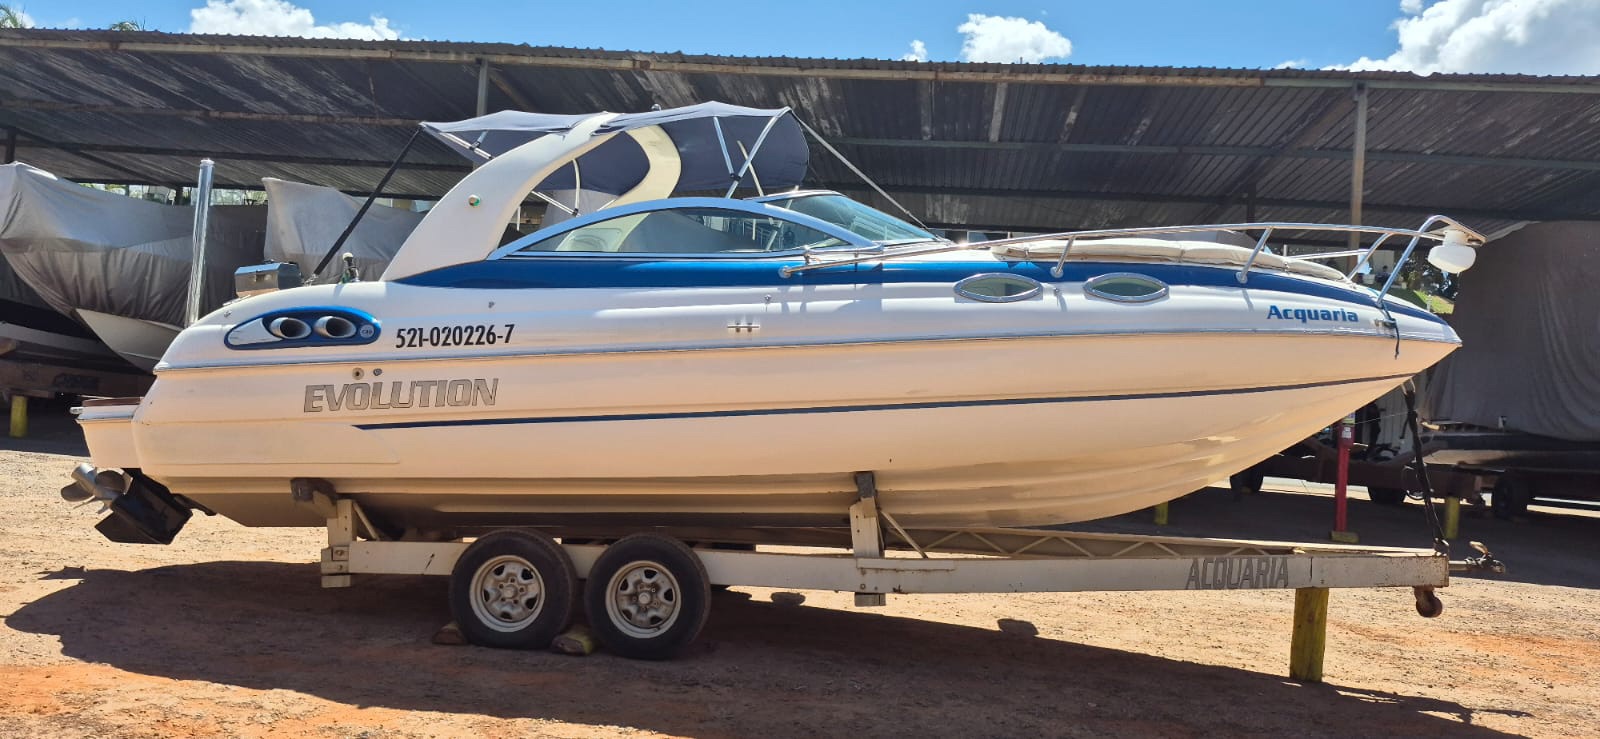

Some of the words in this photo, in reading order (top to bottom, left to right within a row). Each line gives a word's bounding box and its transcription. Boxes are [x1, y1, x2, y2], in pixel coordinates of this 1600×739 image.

[1267, 305, 1358, 323] Acquaria
[395, 324, 514, 349] 521-020226-7
[304, 378, 498, 412] EVOLUTION
[1186, 556, 1289, 590] ACQUARIA
